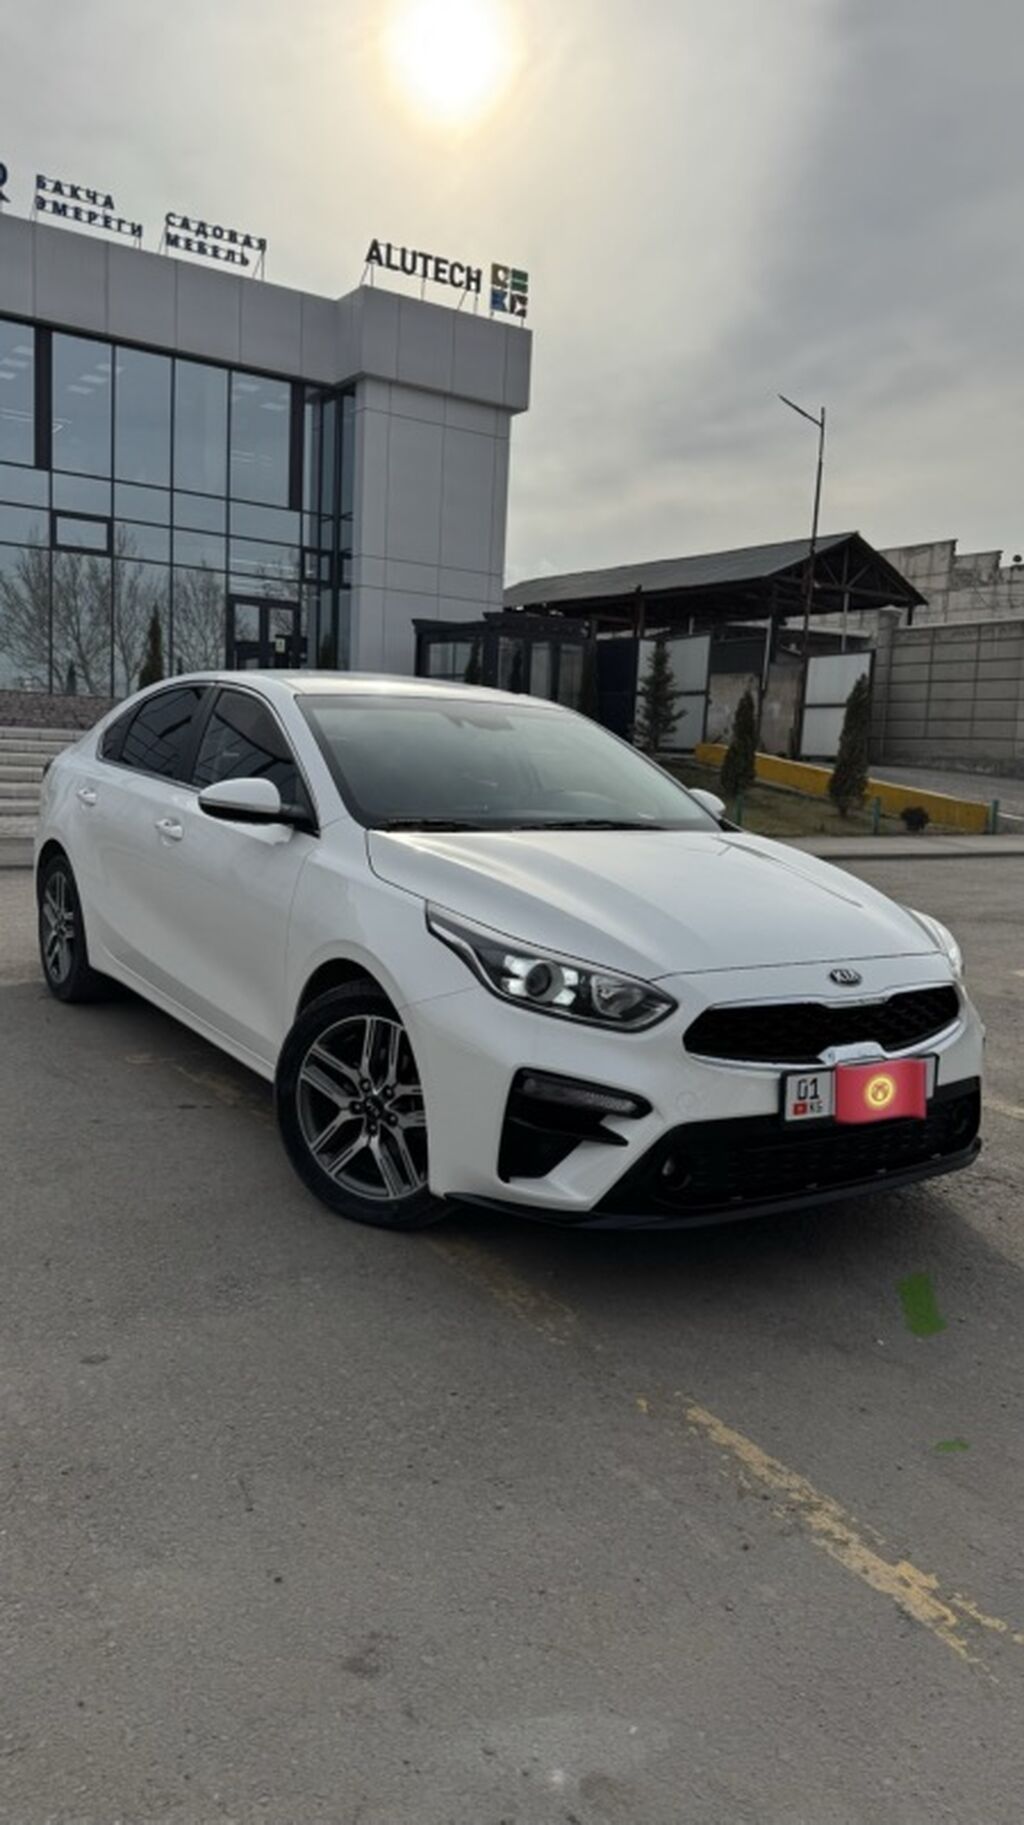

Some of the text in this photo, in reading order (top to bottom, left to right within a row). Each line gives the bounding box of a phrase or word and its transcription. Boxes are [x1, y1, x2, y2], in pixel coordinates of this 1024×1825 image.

[36, 174, 115, 210] БАКЧА
[35, 195, 143, 238] ЭМЕРЕГИ
[165, 212, 267, 250] САДОВАЯ
[166, 232, 250, 266] МЕБЕЛЬ
[365, 238, 482, 294] ALUTECH
[830, 968, 861, 985] KIA
[797, 1077, 819, 1100] 01
